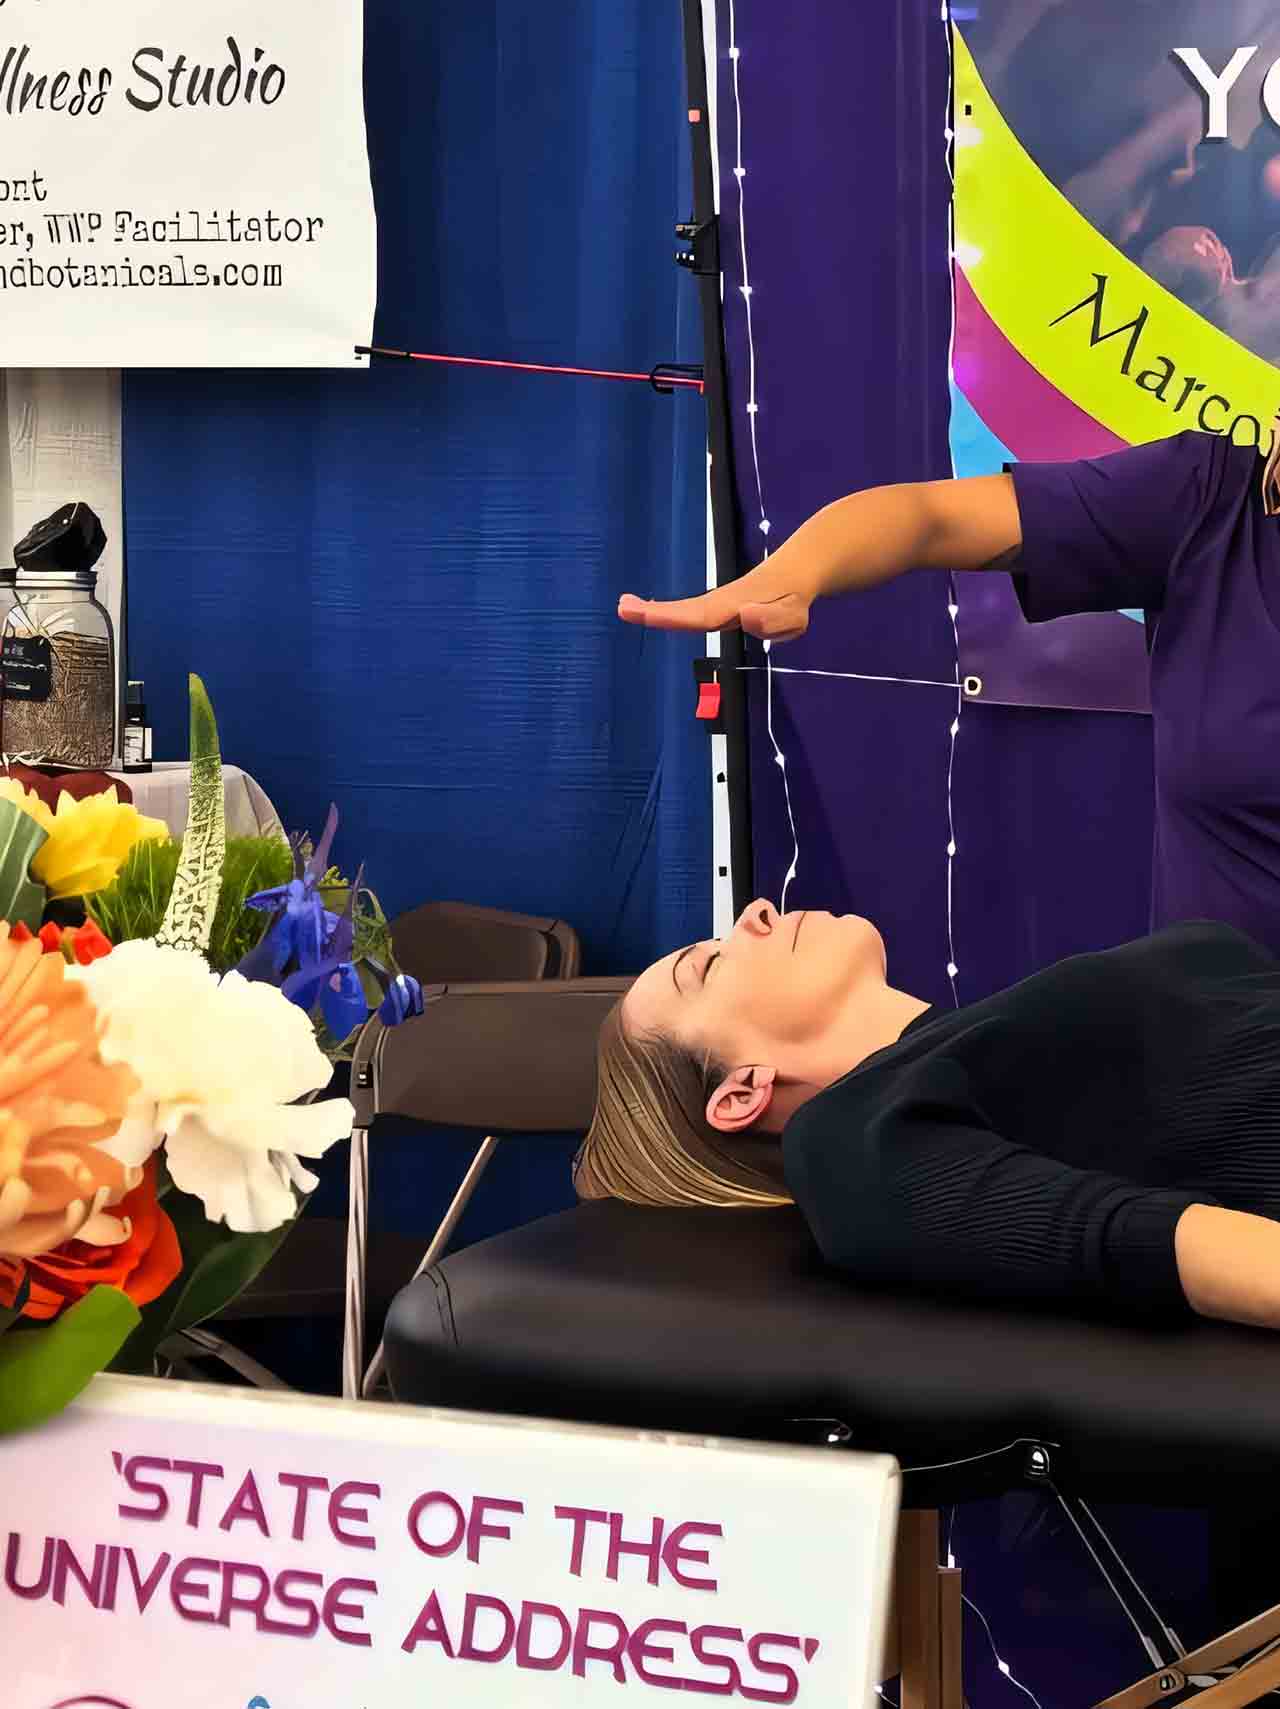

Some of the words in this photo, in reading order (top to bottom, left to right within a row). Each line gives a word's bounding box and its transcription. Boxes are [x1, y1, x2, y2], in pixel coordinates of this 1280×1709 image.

[125, 36, 286, 113] Studio
[113, 210, 325, 243] Facilitator
[406, 1490, 524, 1565] OF
[553, 1505, 723, 1592] THE
[4, 1532, 378, 1647] UNIVERSE
